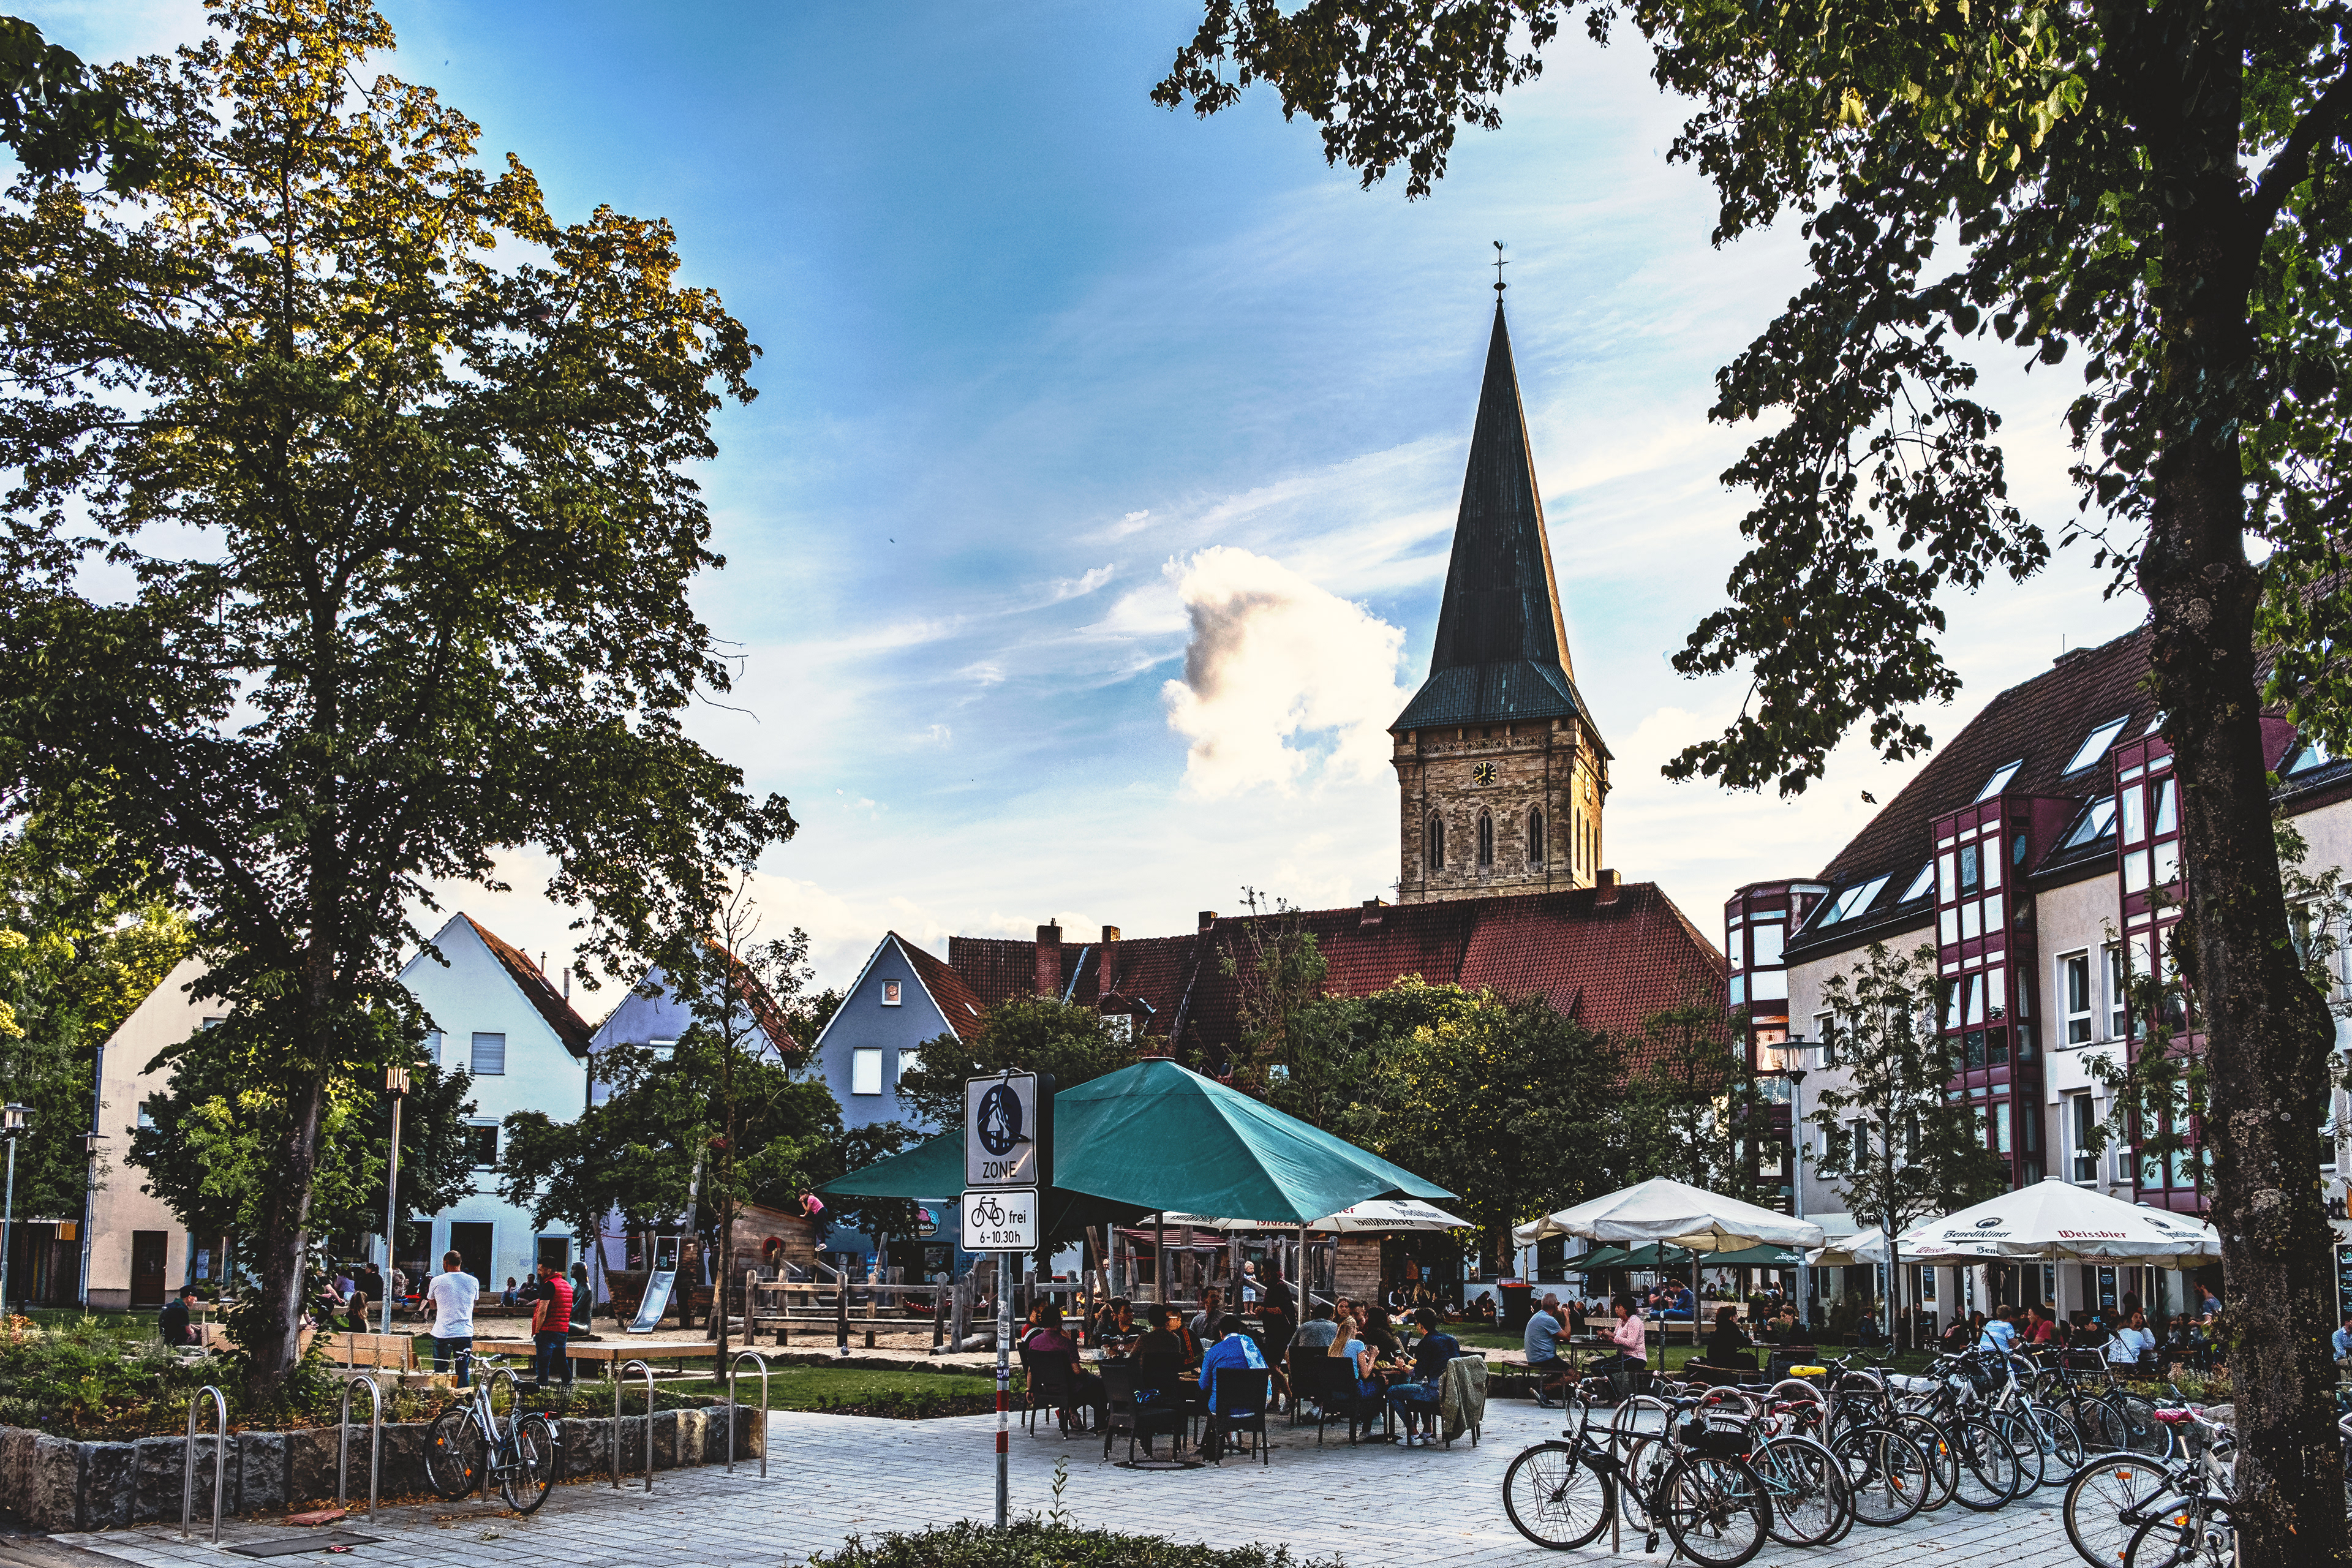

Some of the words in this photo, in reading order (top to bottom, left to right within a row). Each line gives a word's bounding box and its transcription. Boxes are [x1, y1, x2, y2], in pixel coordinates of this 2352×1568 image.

[982, 1161, 1017, 1178] ZONE
[1009, 1210, 1026, 1224] frei
[1942, 1231, 2011, 1239] Benediktiner
[2057, 1230, 2127, 1238] Weissbier
